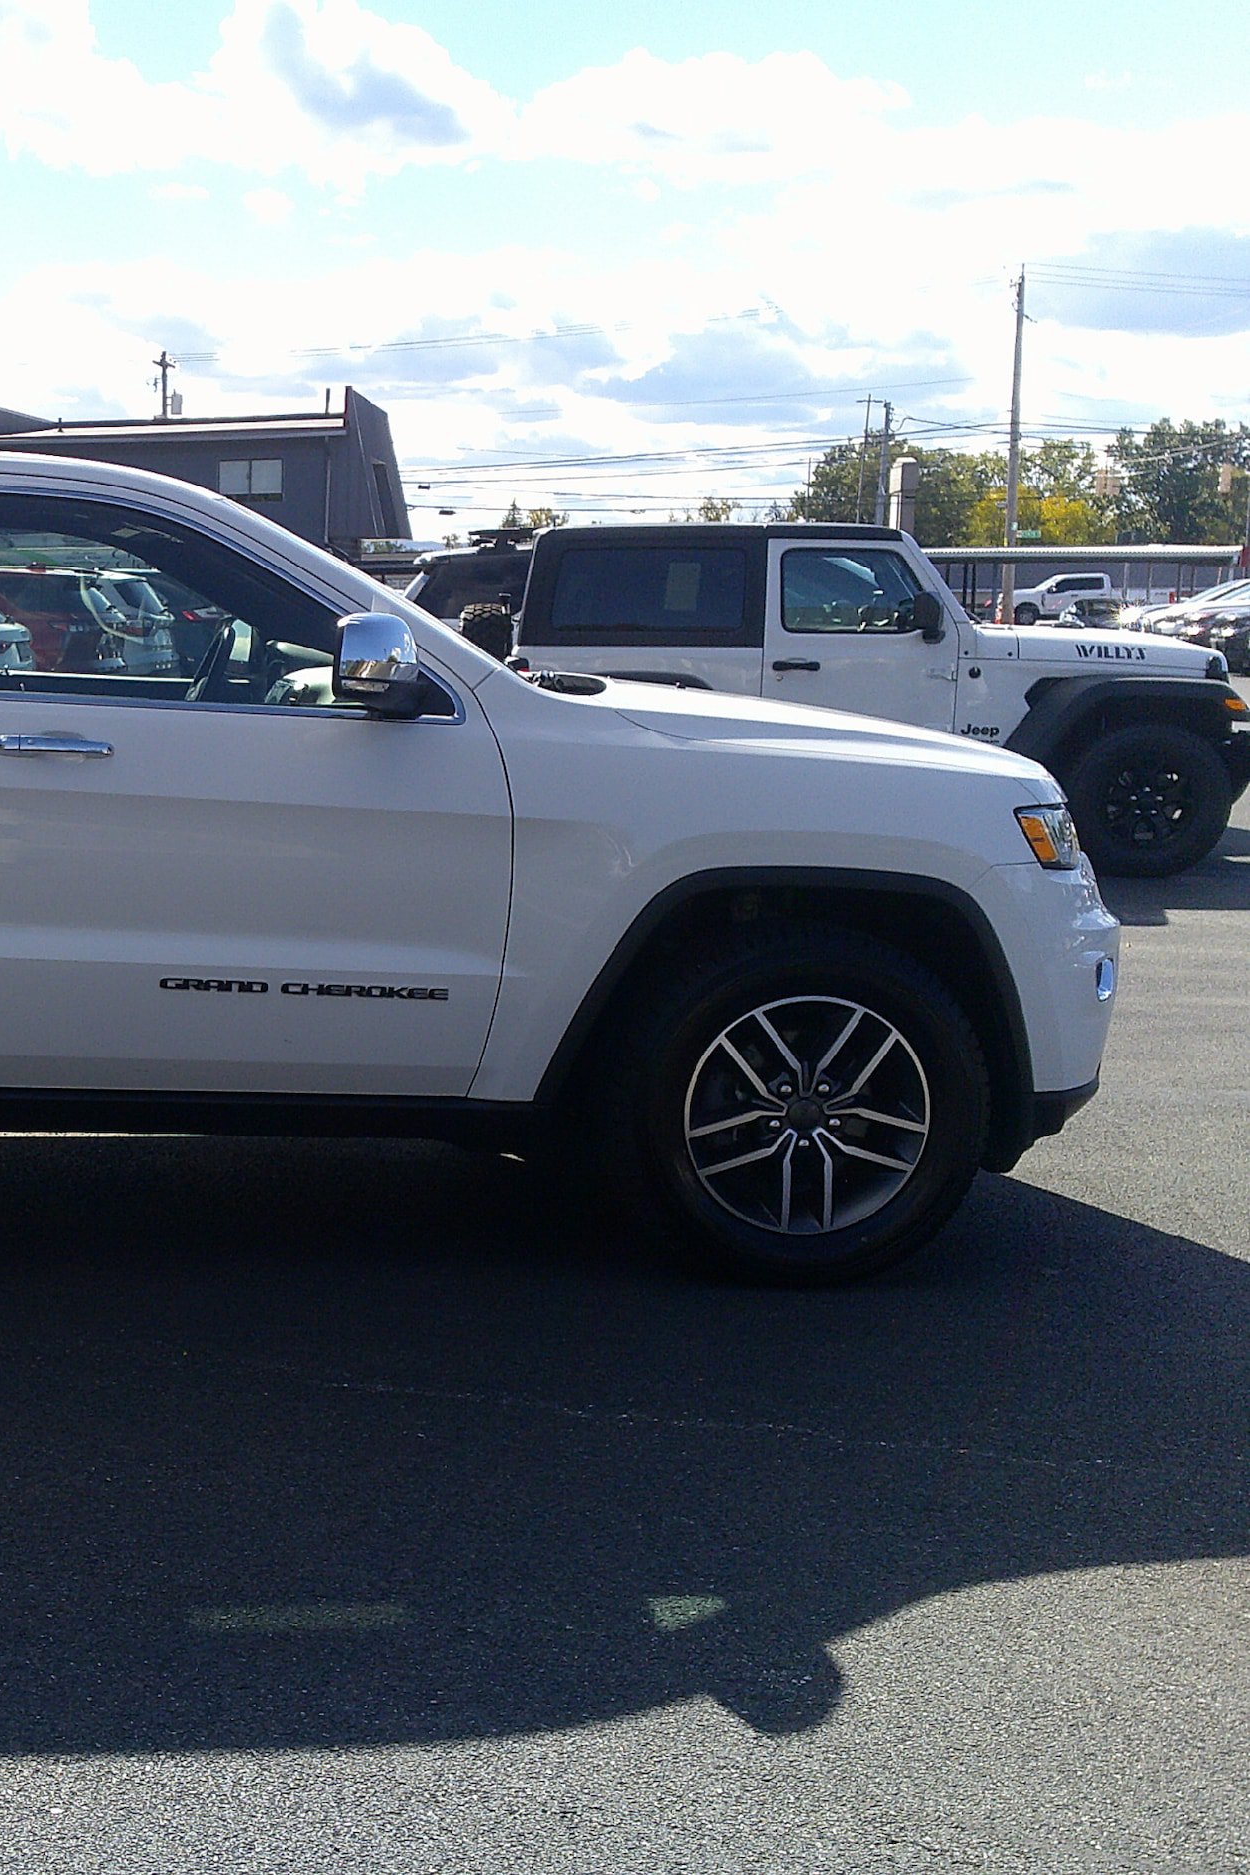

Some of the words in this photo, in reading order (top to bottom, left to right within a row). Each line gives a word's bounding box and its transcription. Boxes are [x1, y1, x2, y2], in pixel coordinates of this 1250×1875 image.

[1075, 644, 1146, 660] WILLYS
[960, 723, 1000, 738] Jeep
[159, 977, 269, 993] GRAND
[281, 982, 449, 1001] CHEROKEE
